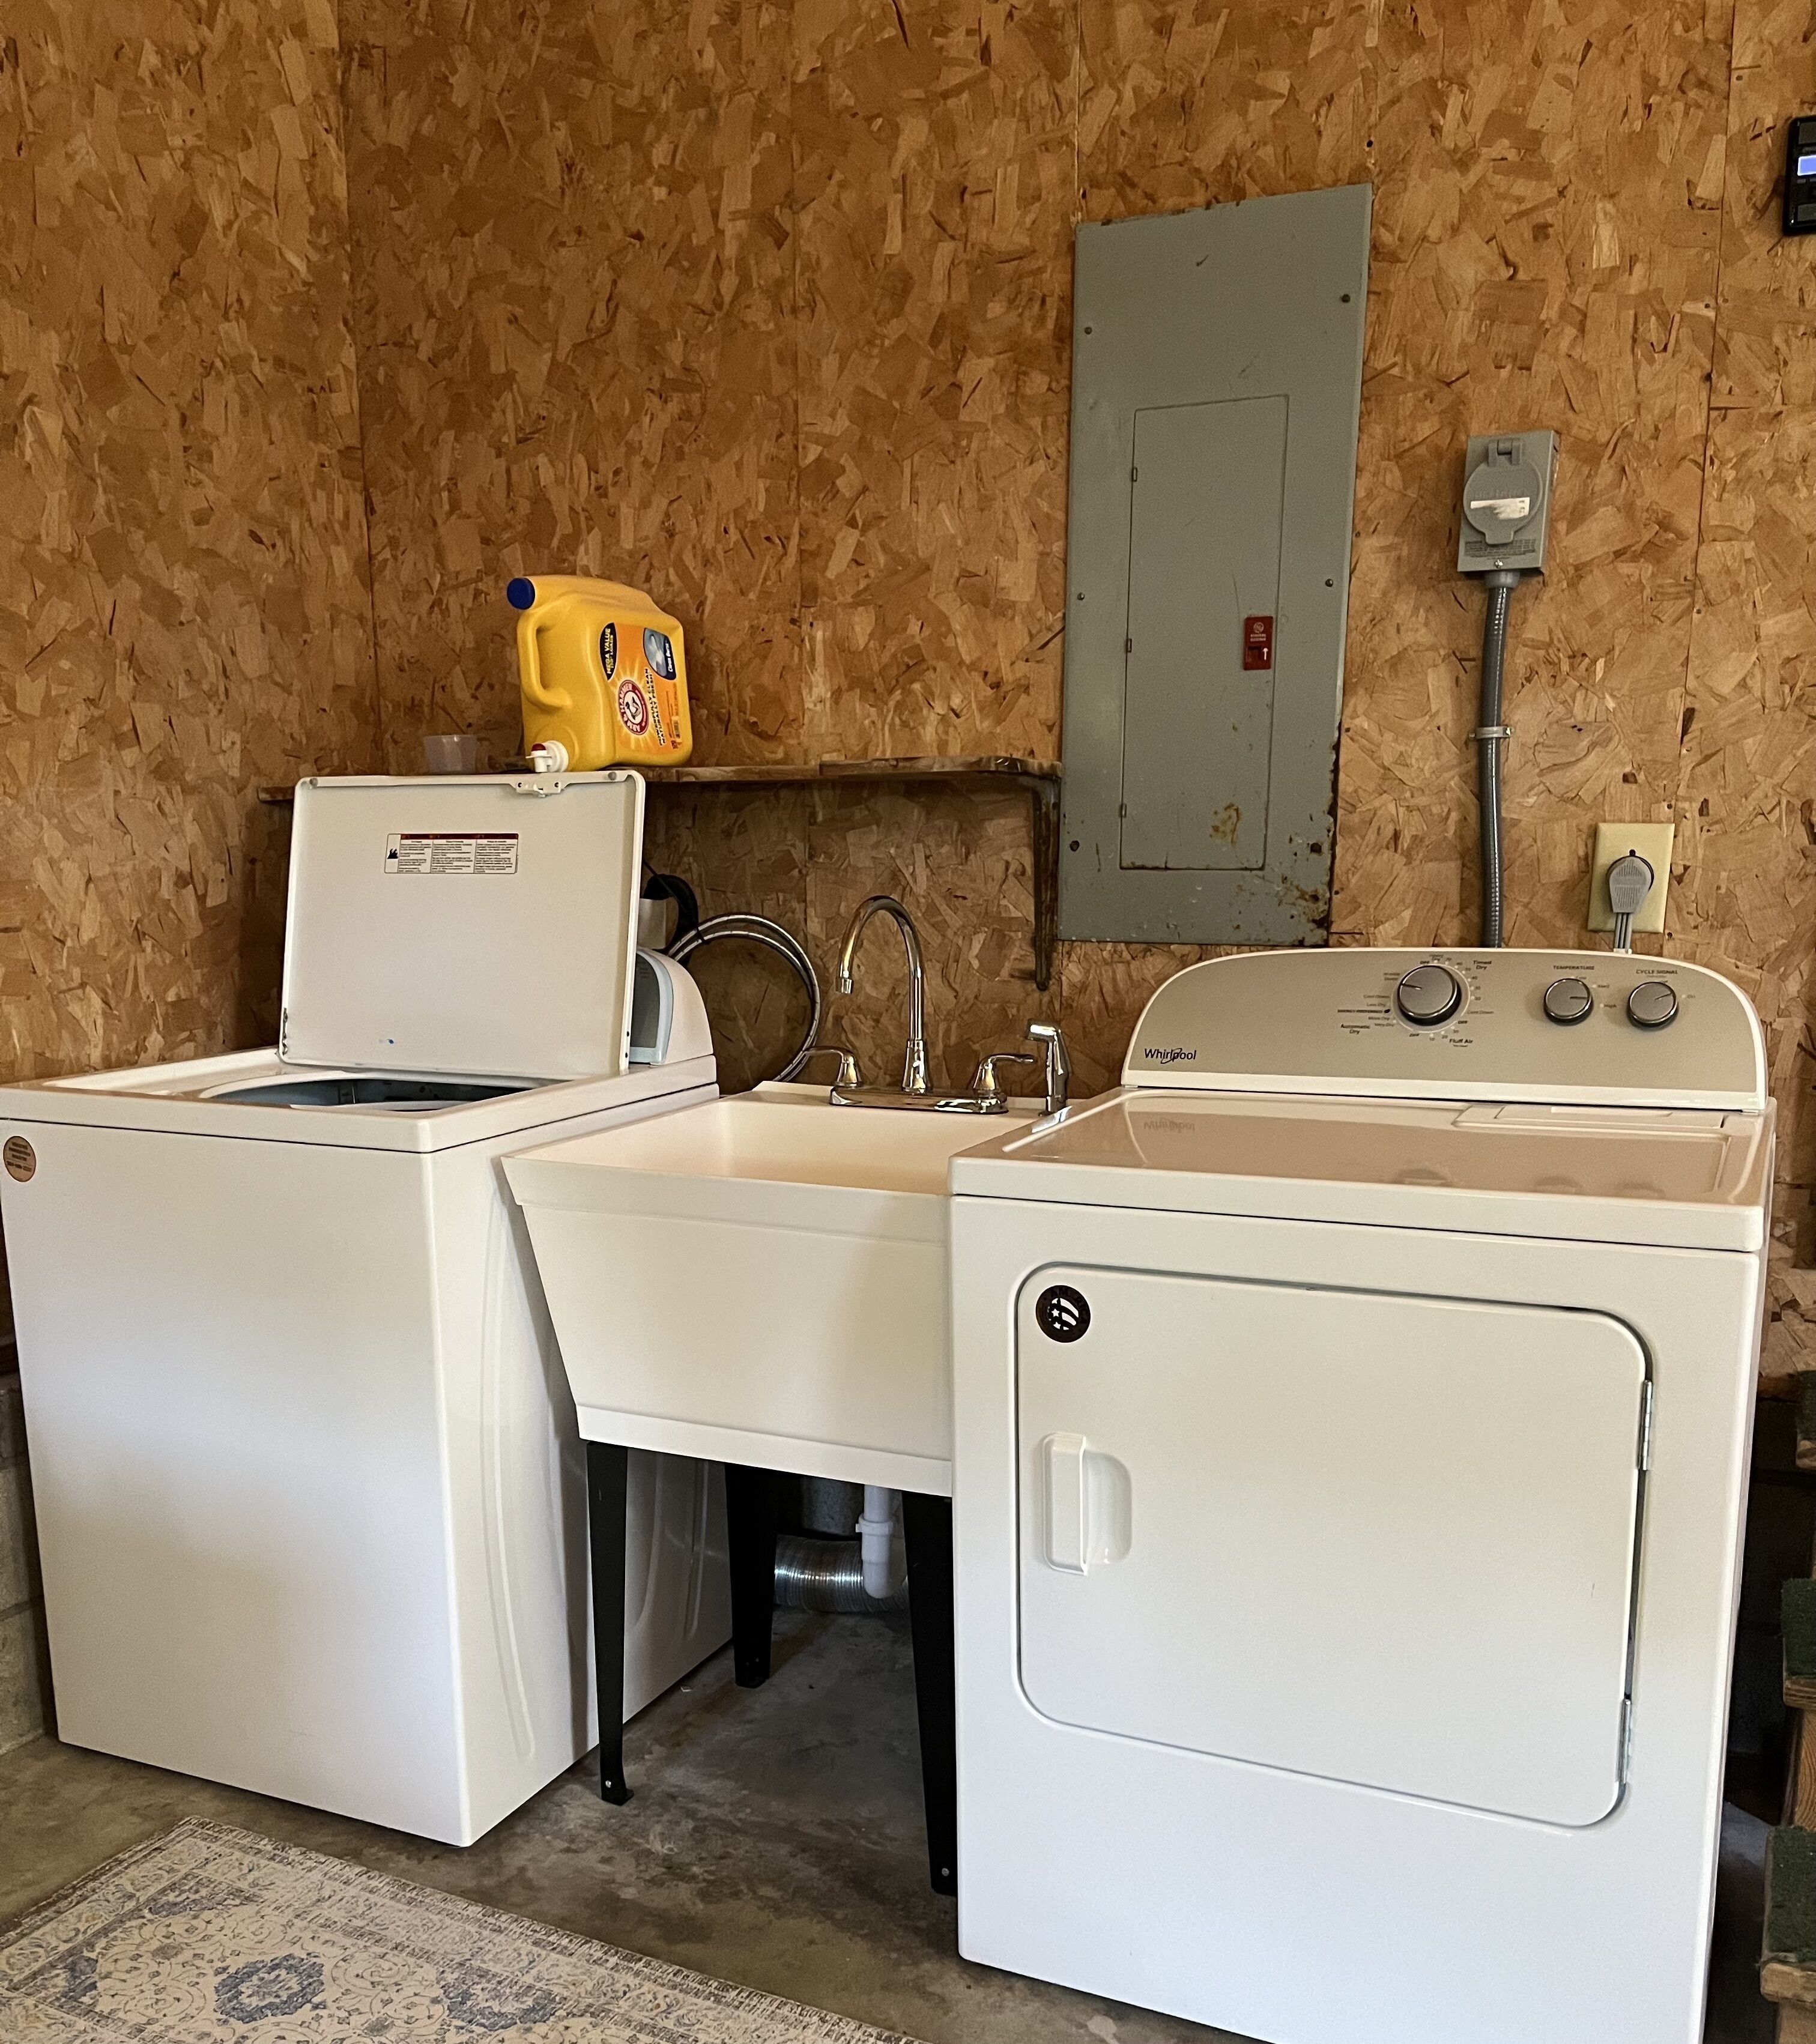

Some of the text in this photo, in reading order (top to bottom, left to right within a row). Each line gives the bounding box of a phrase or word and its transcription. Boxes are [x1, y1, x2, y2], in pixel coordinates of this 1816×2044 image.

[649, 697, 662, 746] POWERFULLY
[653, 701, 665, 744] NATURALLY
[1145, 1047, 1197, 1064] Whirlpool
